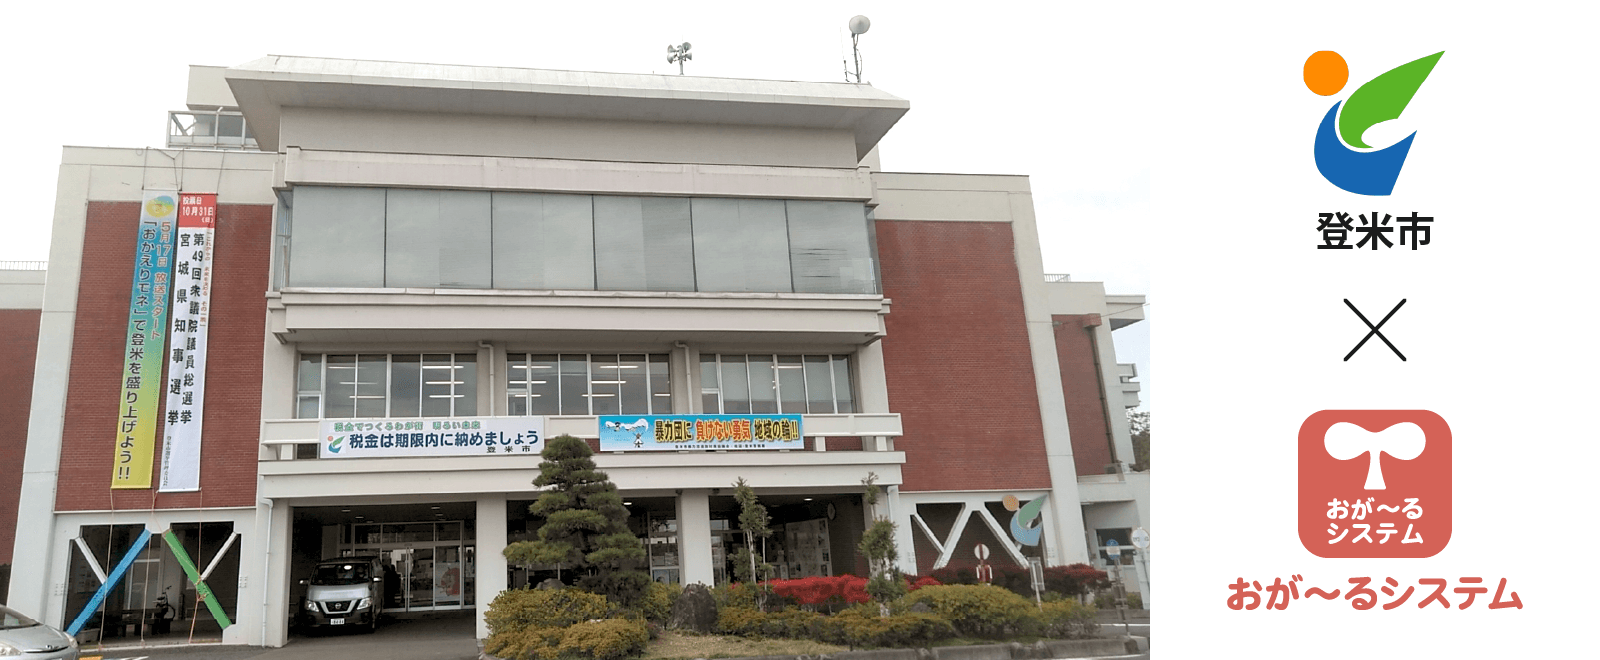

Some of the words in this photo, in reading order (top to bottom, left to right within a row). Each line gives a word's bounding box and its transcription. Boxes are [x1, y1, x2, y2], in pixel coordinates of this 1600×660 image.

[182, 207, 214, 217] 10月31日
[156, 221, 172, 267] 5月17日
[151, 272, 167, 340] 放送スタート
[167, 233, 190, 425] 宮城県知事選挙
[180, 233, 205, 424] 第49回衆議院議員総選挙
[349, 430, 539, 449] 税金は期限内に納めましょう
[655, 420, 693, 441] 暴力団に
[696, 420, 752, 441] 負けない勇気
